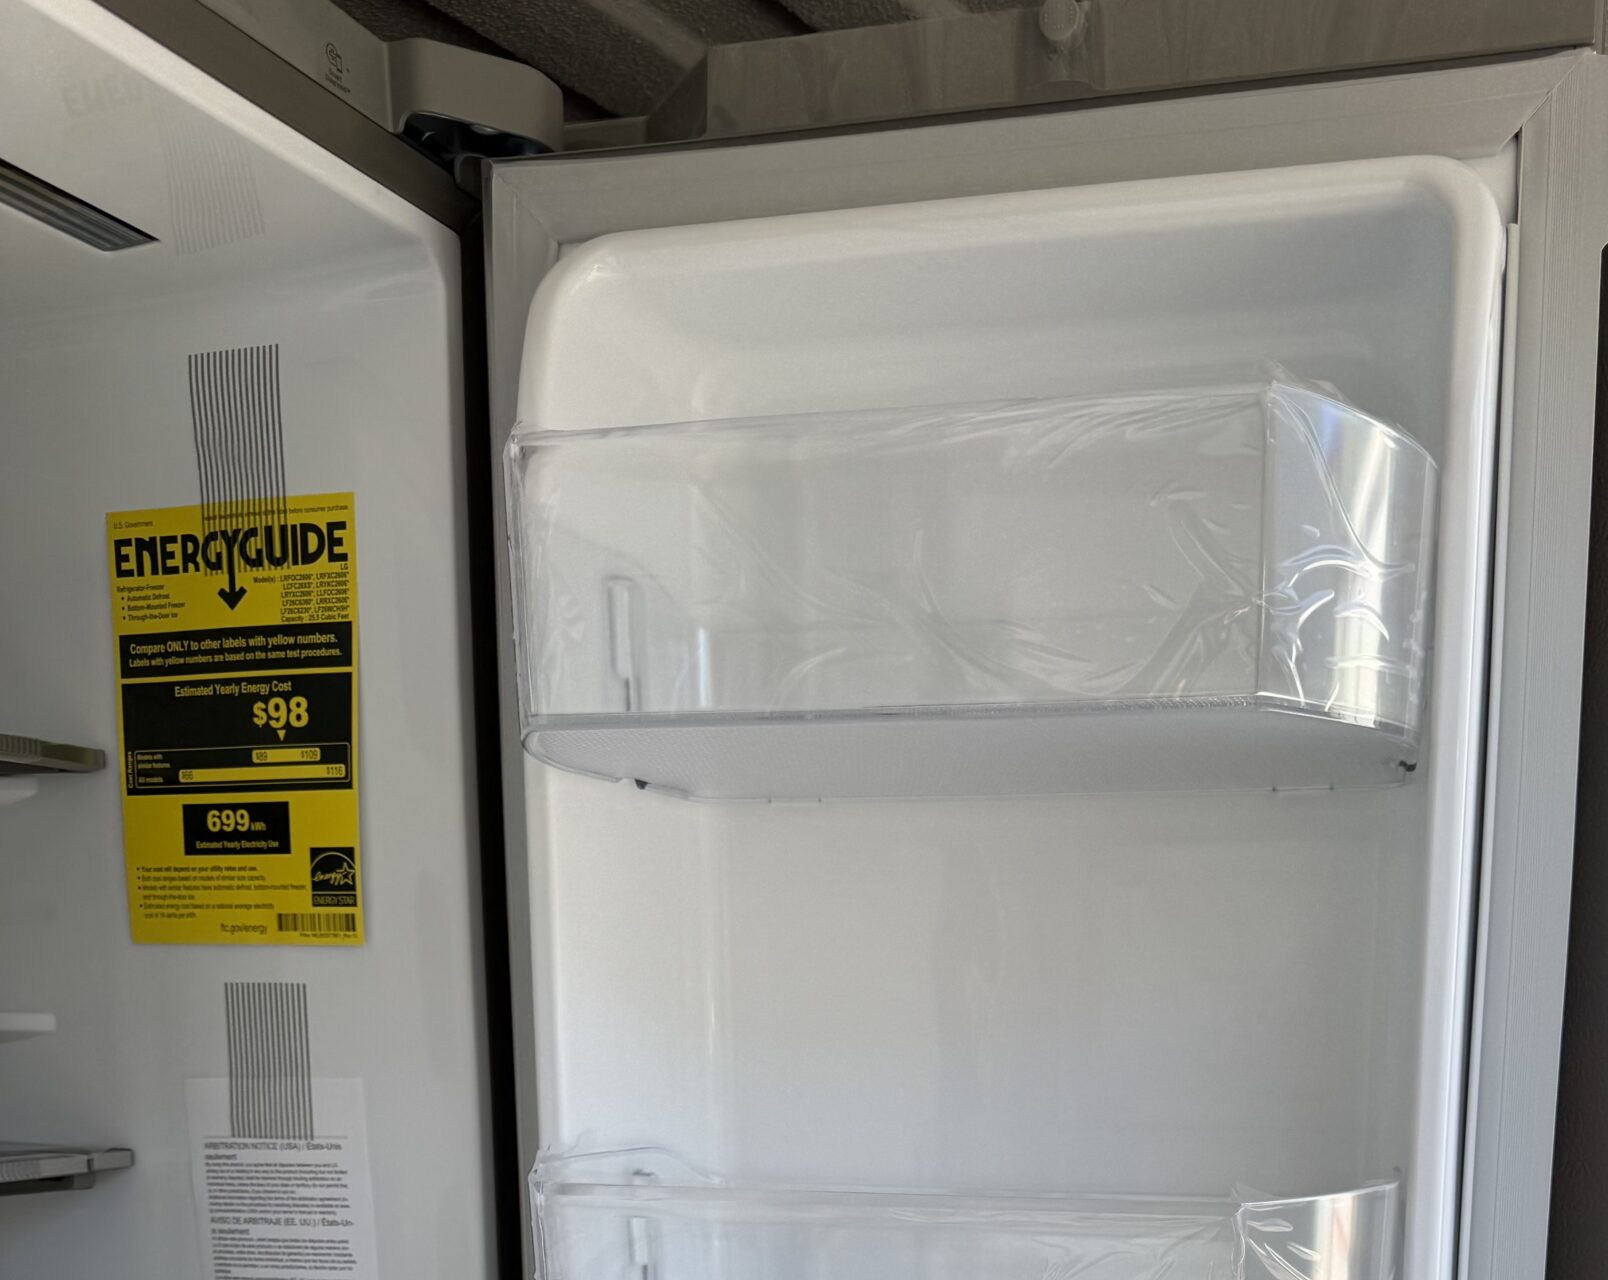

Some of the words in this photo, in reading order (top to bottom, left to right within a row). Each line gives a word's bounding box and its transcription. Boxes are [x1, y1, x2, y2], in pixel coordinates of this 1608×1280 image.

[114, 521, 348, 579] ENERGYGUIDE
[130, 643, 165, 655] Compare
[166, 640, 190, 652] ONLY
[191, 640, 199, 650] to
[200, 638, 221, 649] other
[222, 637, 246, 648] labels
[249, 635, 266, 646] with
[267, 634, 295, 648] yellow
[297, 633, 339, 644] numbers.
[129, 658, 150, 668] Labels
[151, 657, 164, 666] with
[165, 656, 185, 667] yellow
[186, 654, 213, 664] numbers
[225, 653, 244, 662] based
[255, 651, 266, 659] the
[287, 649, 300, 658] test
[301, 648, 343, 659] procedures.
[175, 684, 213, 697] Estimated
[214, 683, 238, 697] Yearly
[241, 682, 270, 695] Energy
[271, 680, 292, 692] Cost
[252, 696, 309, 729] $98
[206, 809, 250, 832] 699
[250, 821, 267, 831] kWh
[196, 840, 222, 849] Estimated
[223, 840, 240, 850] Yearly
